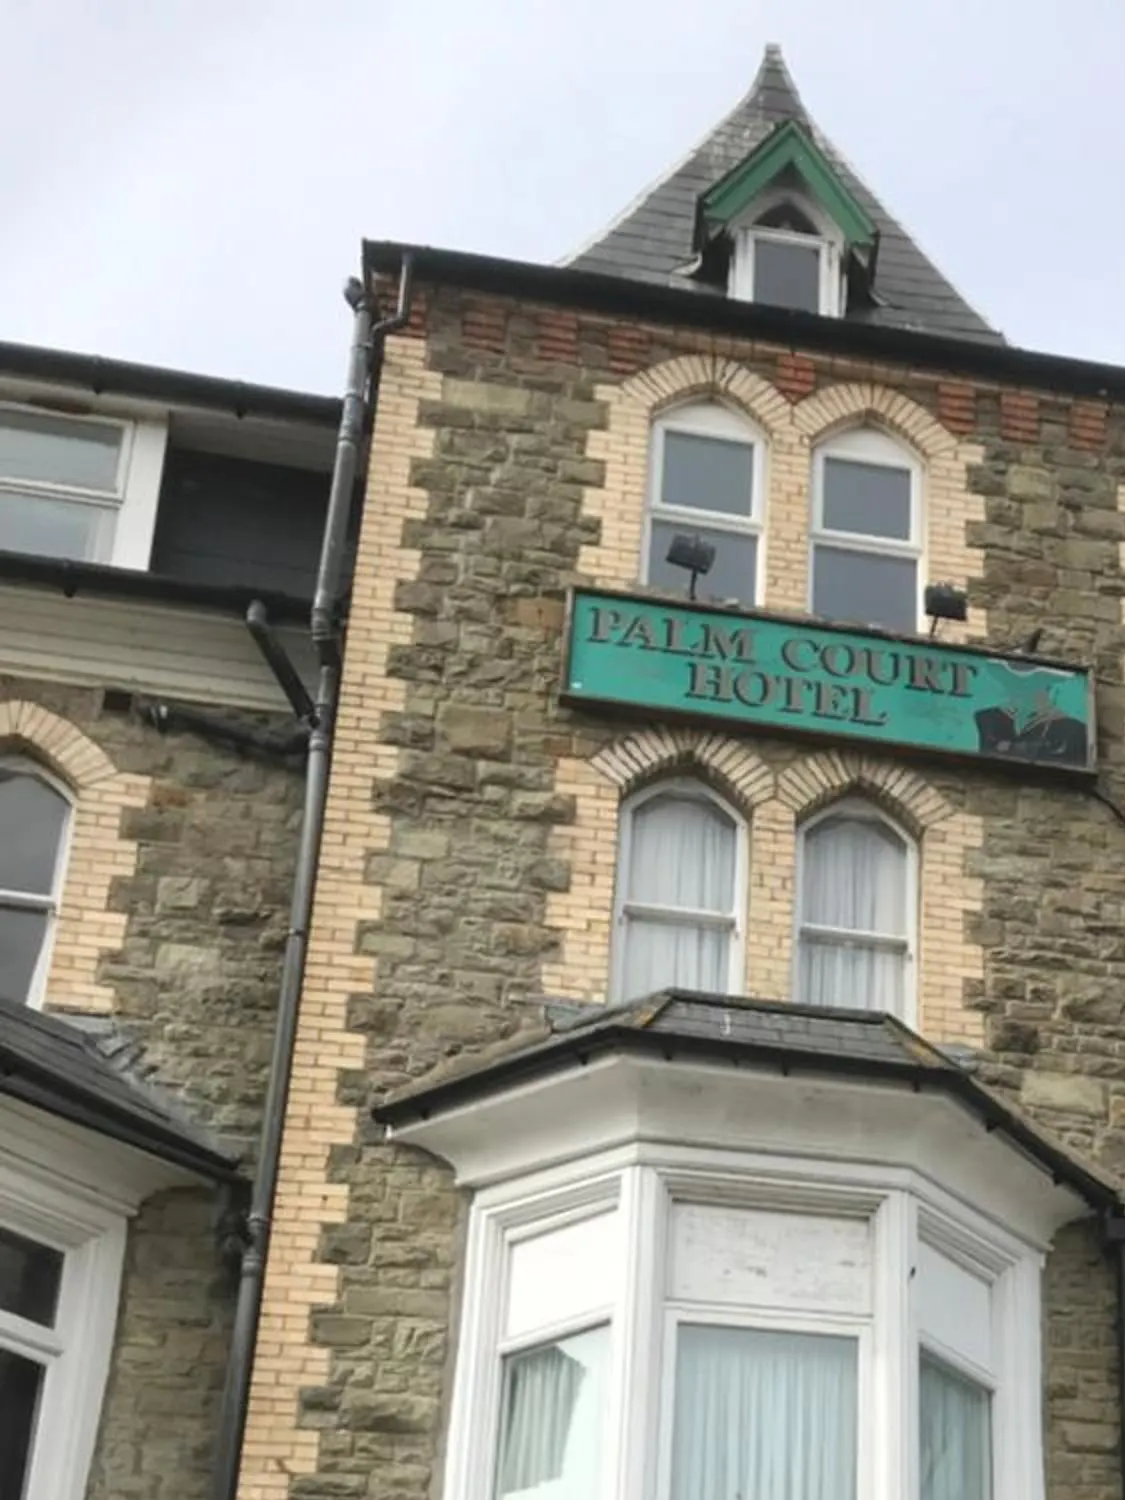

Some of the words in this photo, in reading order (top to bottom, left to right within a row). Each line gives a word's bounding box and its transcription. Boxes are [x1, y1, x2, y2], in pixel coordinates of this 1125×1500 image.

[588, 606, 756, 663] PALM
[782, 638, 978, 697] COURT
[685, 663, 888, 726] HOTEL
